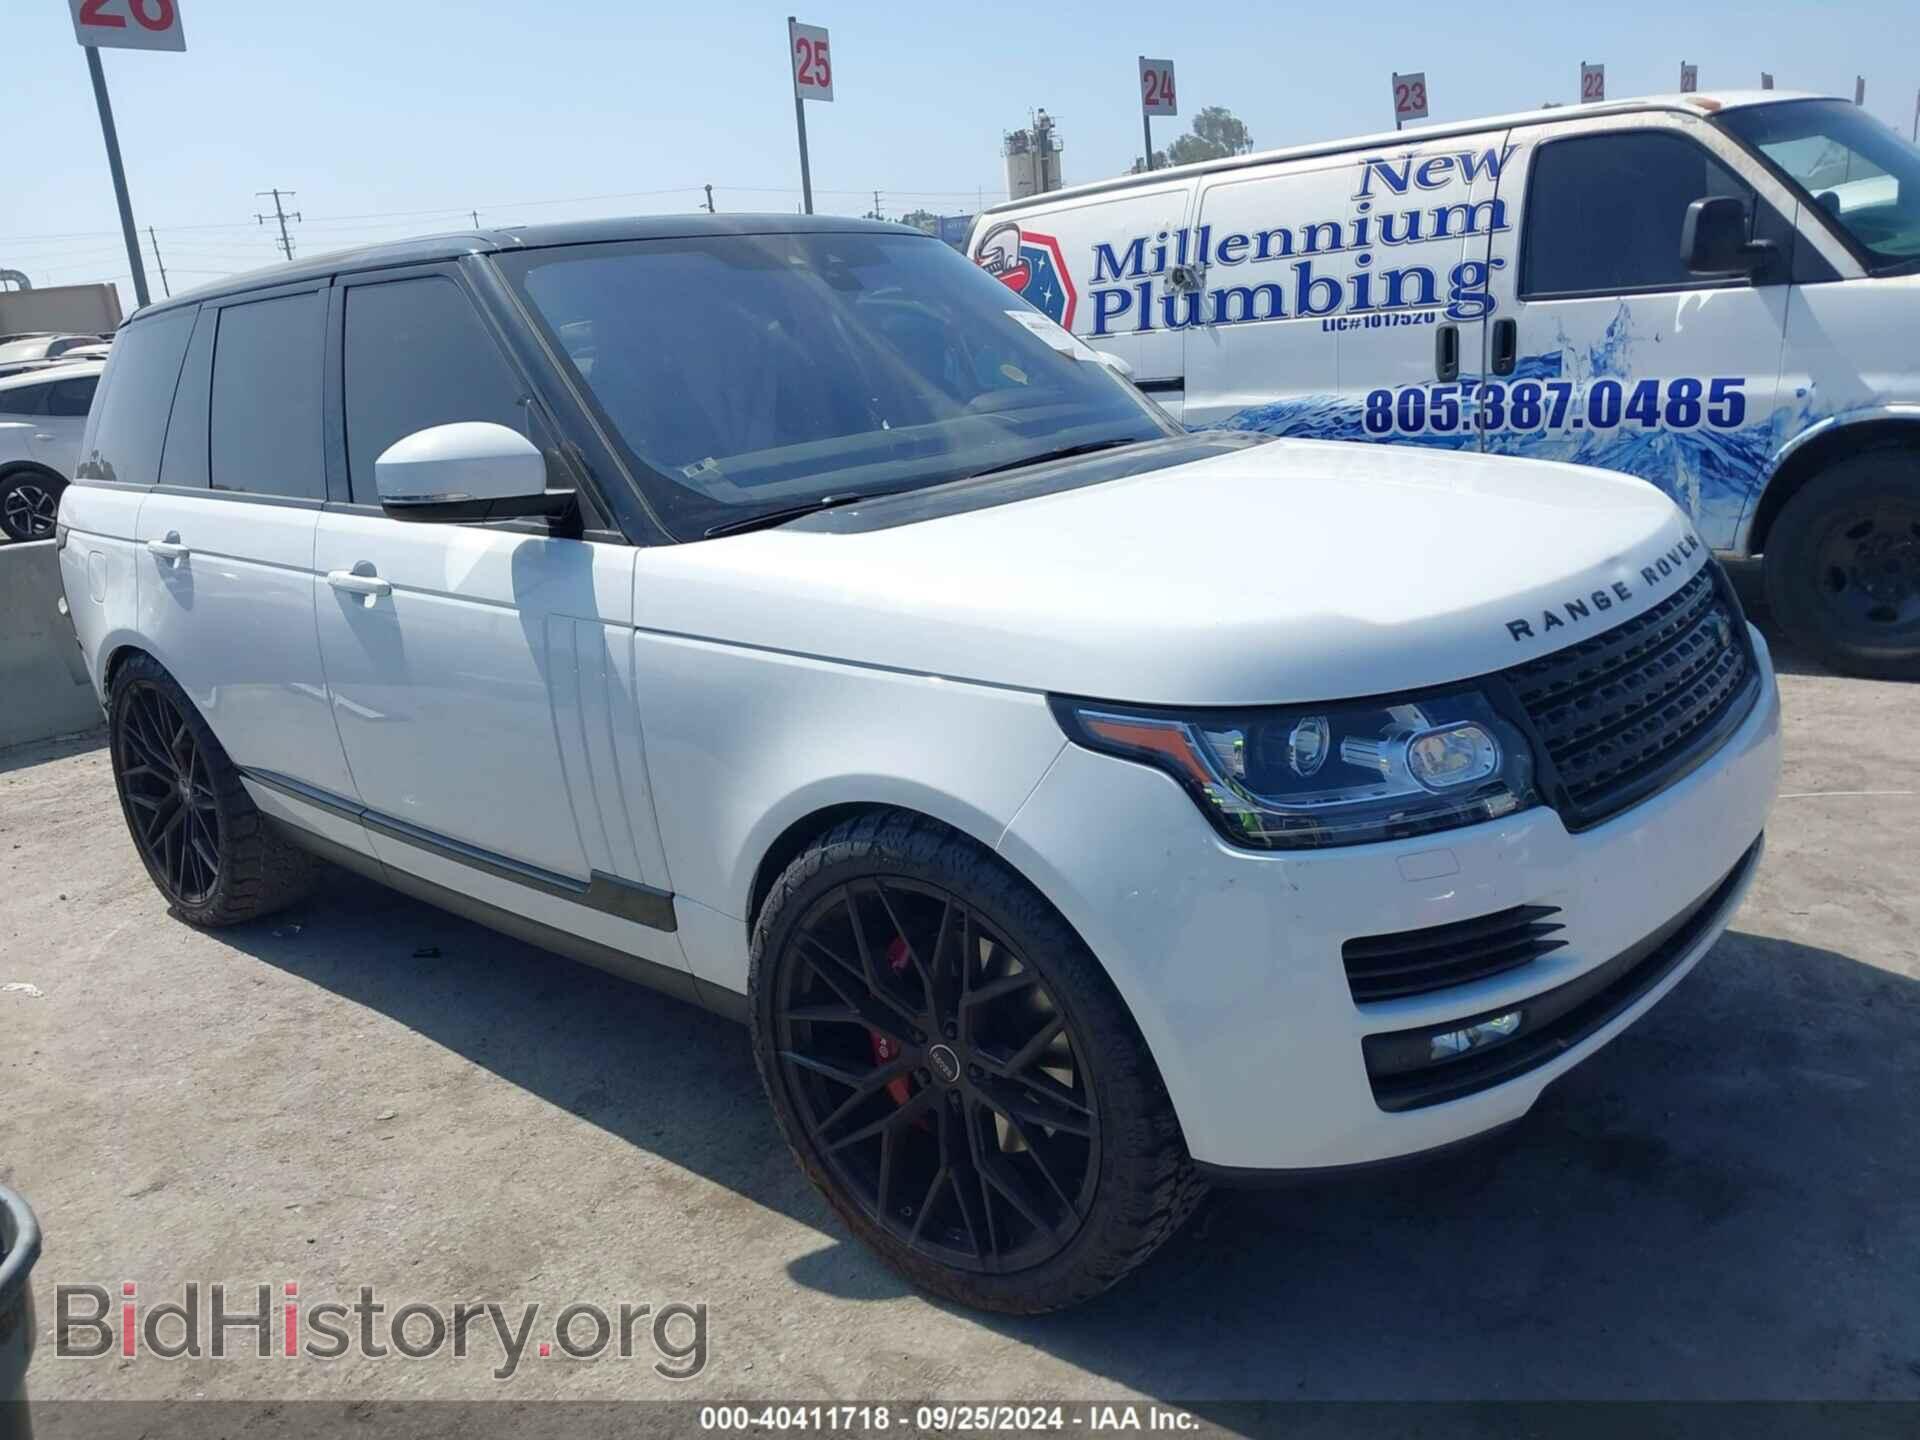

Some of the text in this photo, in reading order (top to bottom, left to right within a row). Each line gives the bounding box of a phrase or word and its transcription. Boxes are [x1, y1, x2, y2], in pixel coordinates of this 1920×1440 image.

[796, 37, 830, 87] 25
[1144, 70, 1174, 106] 24
[1584, 73, 1604, 97] 22
[1396, 82, 1425, 112] 23
[1352, 143, 1519, 199] New
[1092, 198, 1510, 283] Millennium
[1087, 254, 1505, 338] Plumbing
[1365, 377, 1746, 433] 805.387.0485
[1505, 581, 1633, 642] RANGE
